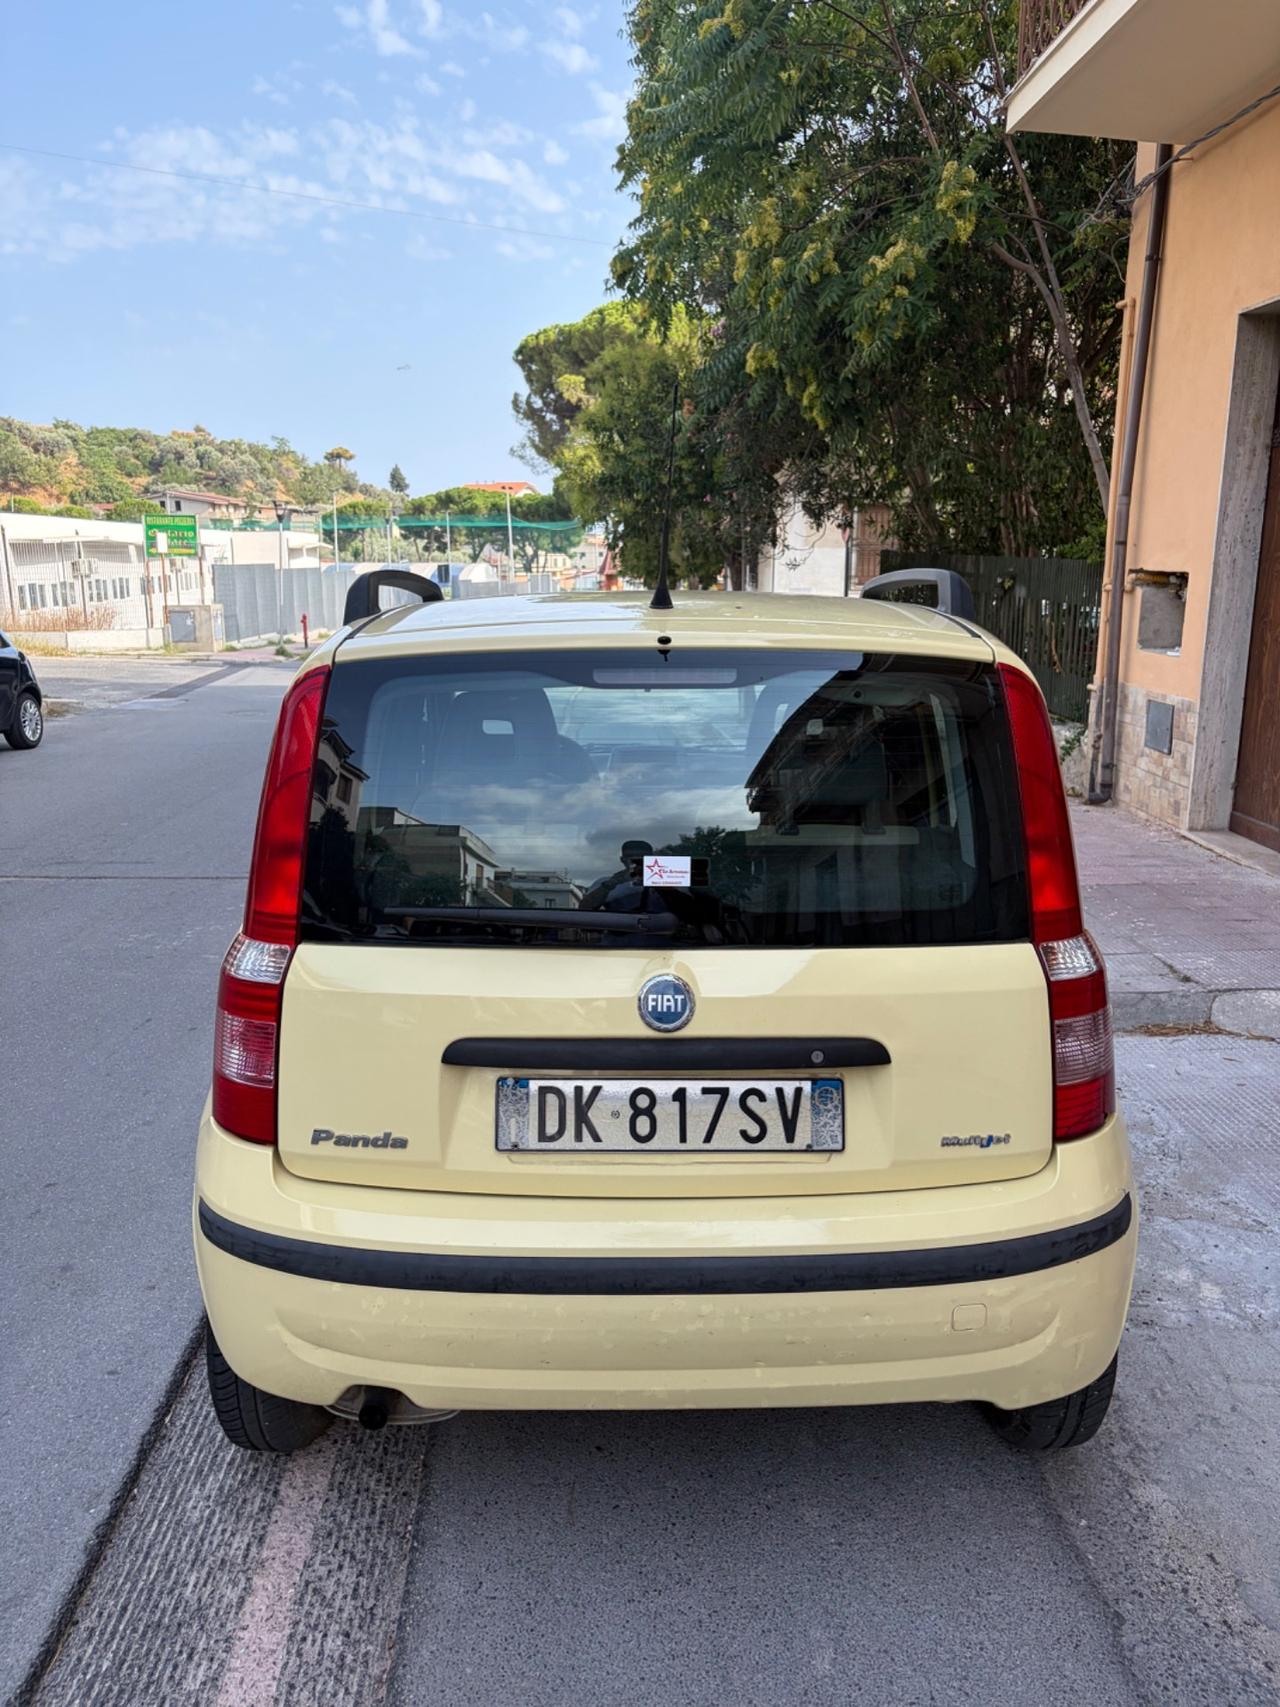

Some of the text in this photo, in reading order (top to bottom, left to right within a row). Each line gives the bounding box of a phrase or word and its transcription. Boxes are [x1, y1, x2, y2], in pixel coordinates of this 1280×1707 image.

[148, 528, 194, 538] Otario
[647, 994, 685, 1012] FIAT
[537, 1085, 603, 1144] DK
[310, 1128, 408, 1149] Panda
